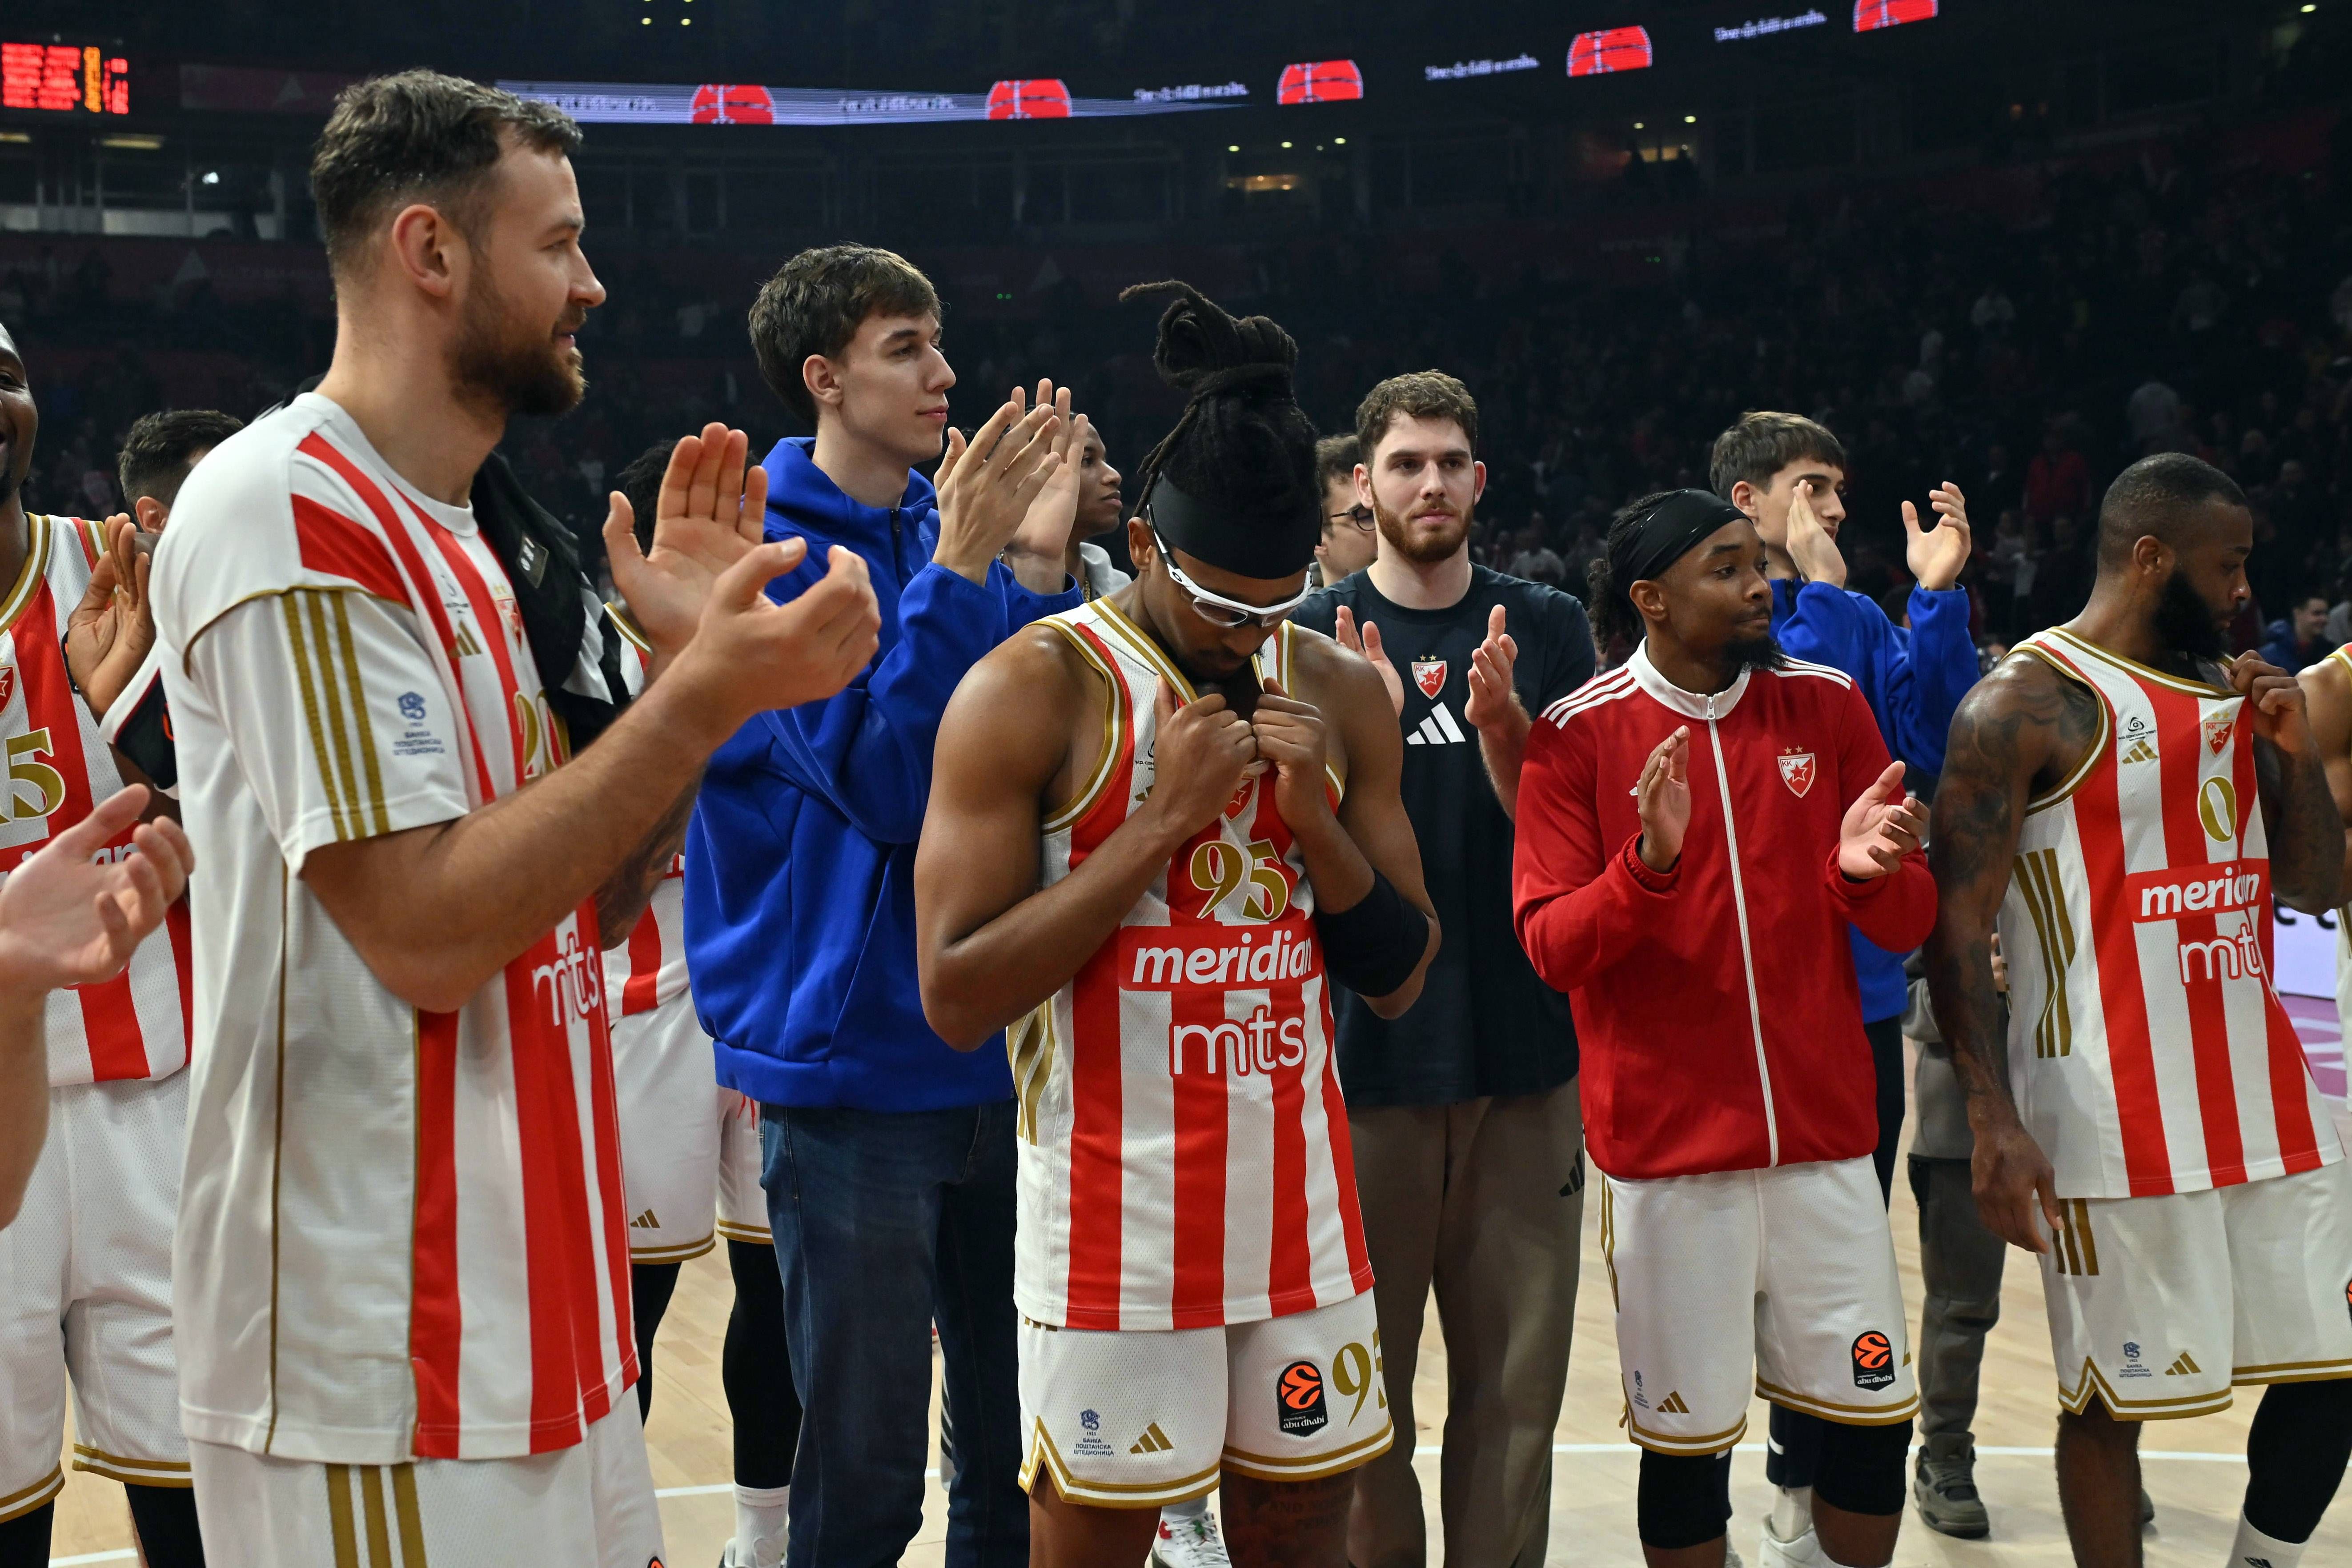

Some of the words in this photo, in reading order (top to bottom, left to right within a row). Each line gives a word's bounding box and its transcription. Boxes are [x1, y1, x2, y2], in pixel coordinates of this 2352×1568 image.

[0, 727, 66, 826] 5
[2197, 775, 2237, 843] 0
[1190, 838, 1288, 922] 95
[532, 936, 600, 1027] mts
[1132, 930, 1312, 984] meridian
[2180, 926, 2261, 983] mt
[1173, 1009, 1304, 1075] mts
[1872, 1374, 1893, 1383] dhabi
[1301, 1415, 1325, 1427] dhabi
